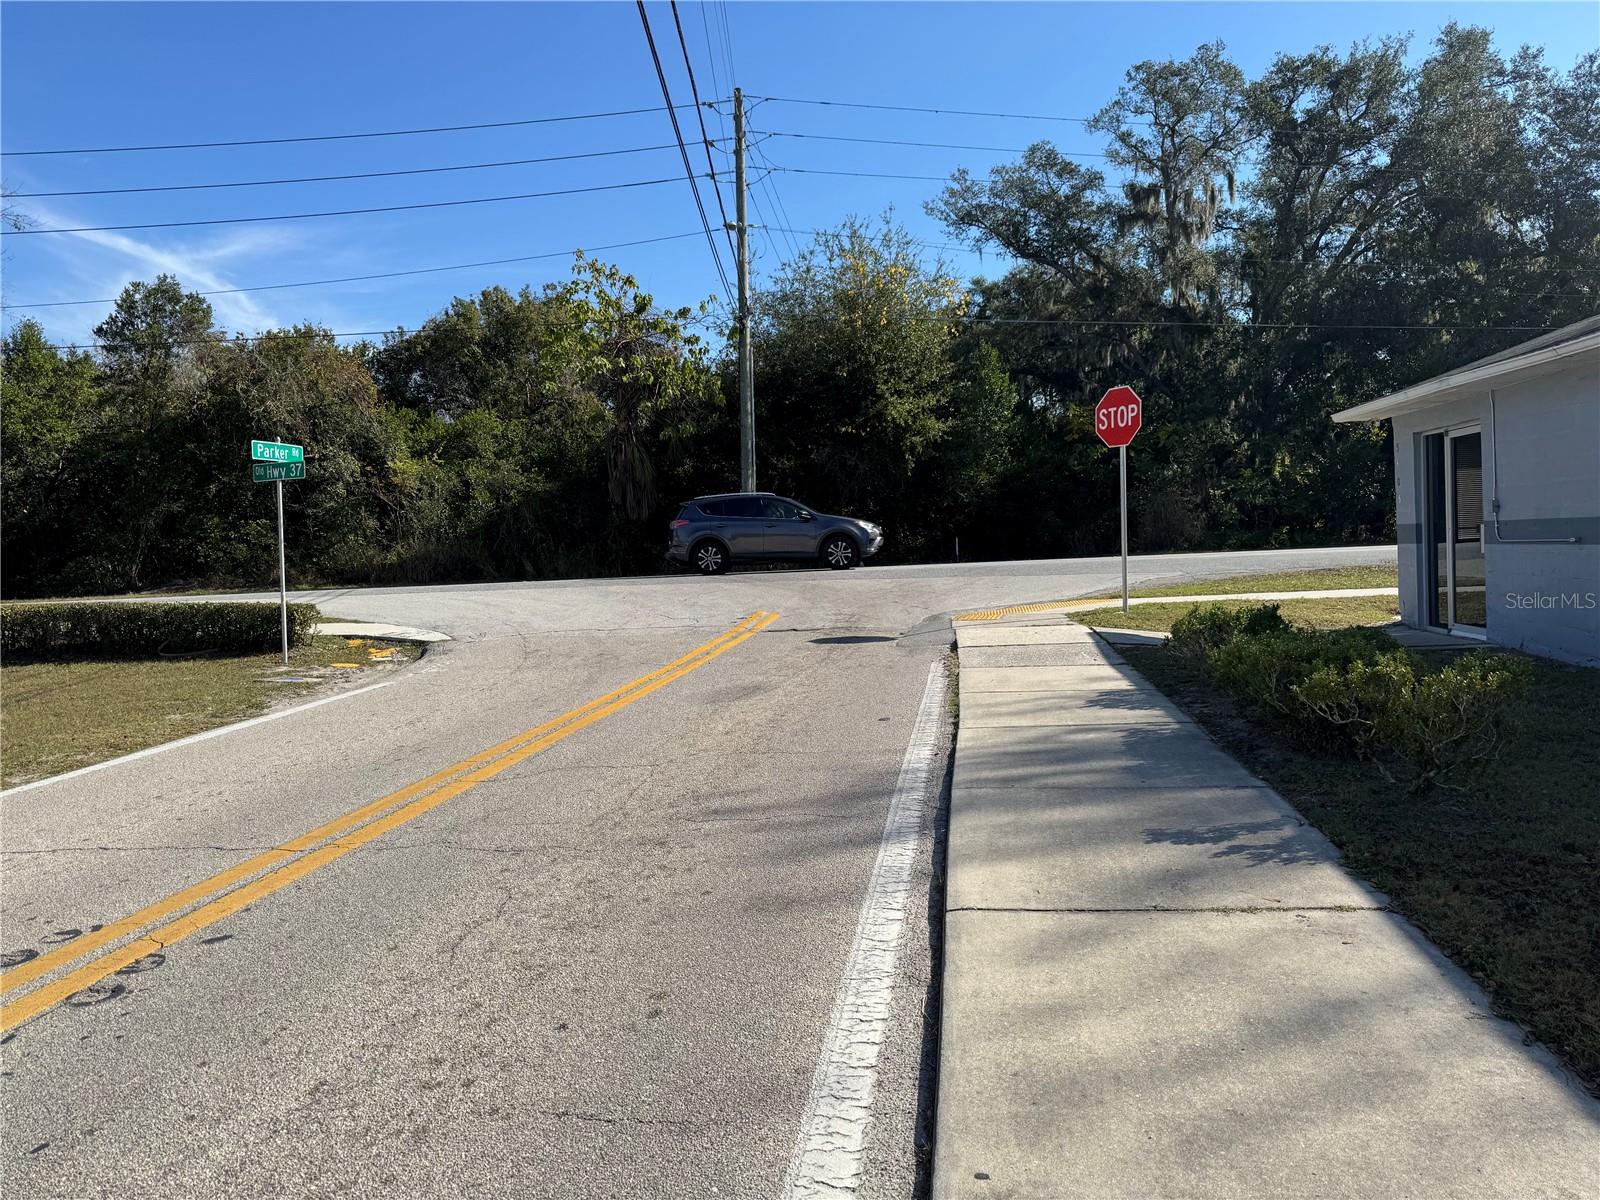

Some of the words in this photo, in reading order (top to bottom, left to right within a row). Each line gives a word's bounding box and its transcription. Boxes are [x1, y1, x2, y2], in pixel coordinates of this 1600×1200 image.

[1099, 404, 1138, 430] STOP
[257, 444, 289, 460] Parker
[291, 448, 299, 457] Rd
[266, 465, 286, 480] Hwy
[290, 463, 302, 477] 37
